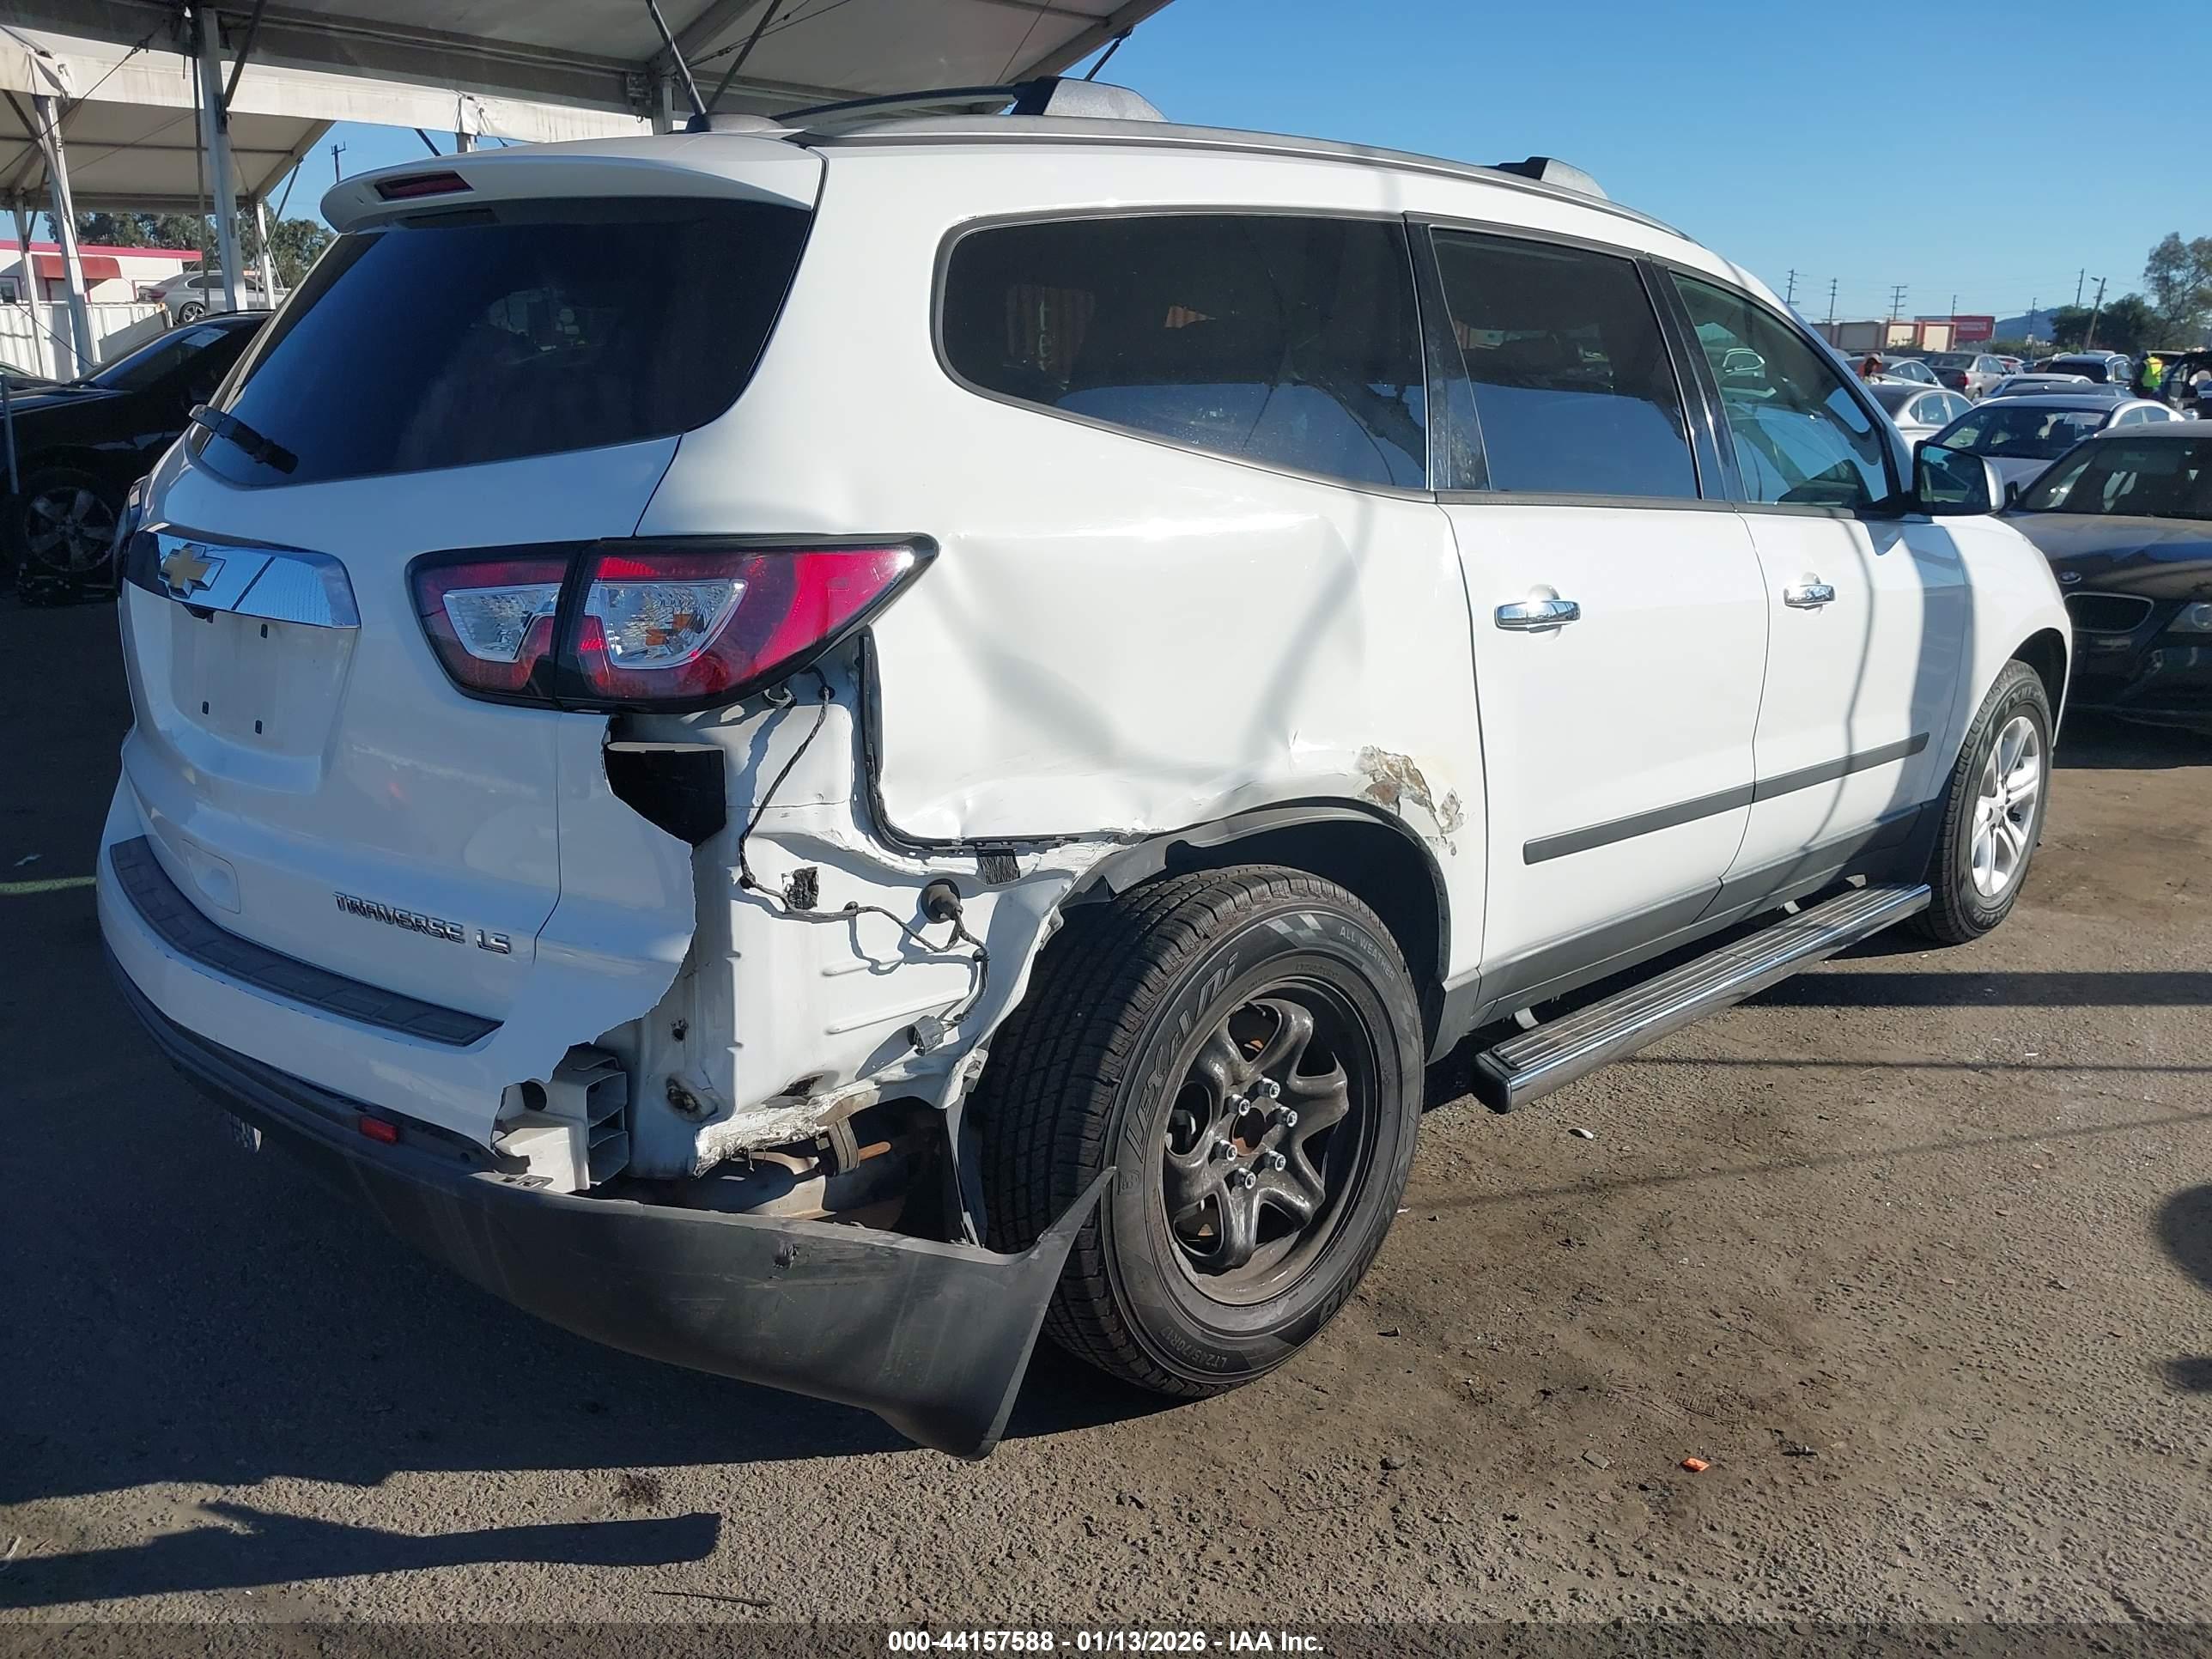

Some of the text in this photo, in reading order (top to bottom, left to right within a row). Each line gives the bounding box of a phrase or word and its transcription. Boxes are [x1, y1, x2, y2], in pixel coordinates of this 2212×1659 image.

[332, 891, 512, 955] TRAVERSE LS
[1340, 926, 1357, 943] ALL
[1359, 935, 1395, 981] WEATHER
